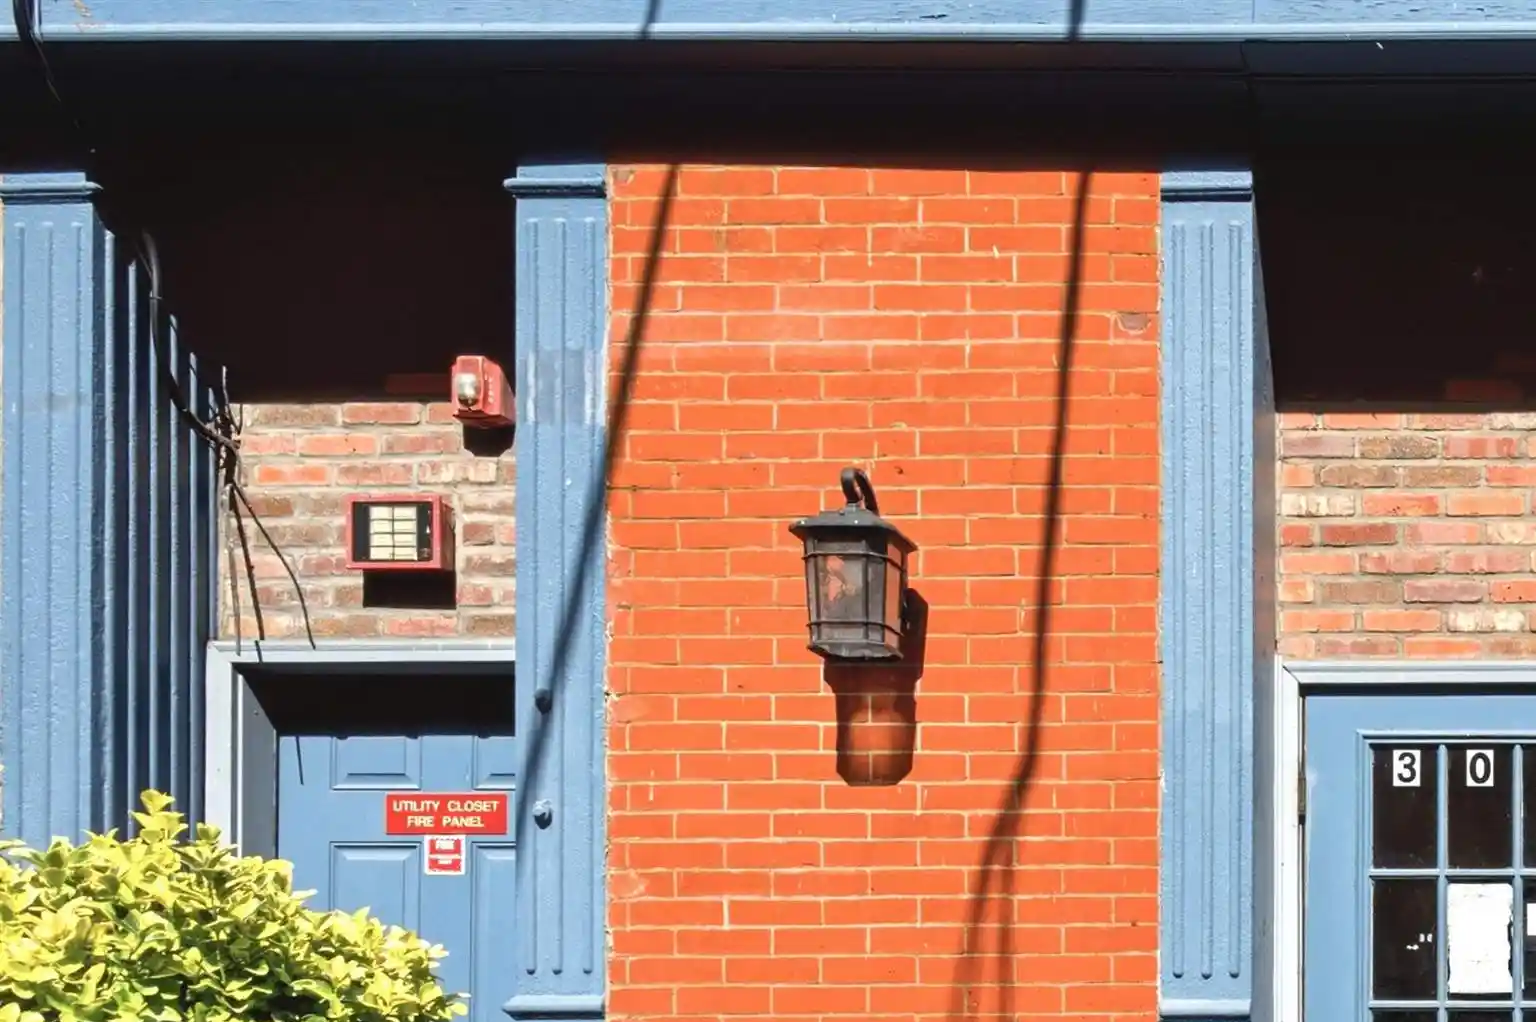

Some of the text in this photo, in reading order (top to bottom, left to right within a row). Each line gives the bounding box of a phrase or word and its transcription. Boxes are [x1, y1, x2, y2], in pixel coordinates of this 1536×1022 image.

[392, 800, 499, 812] UTILITY CLOSET
[407, 816, 485, 828] FIRE PANEL
